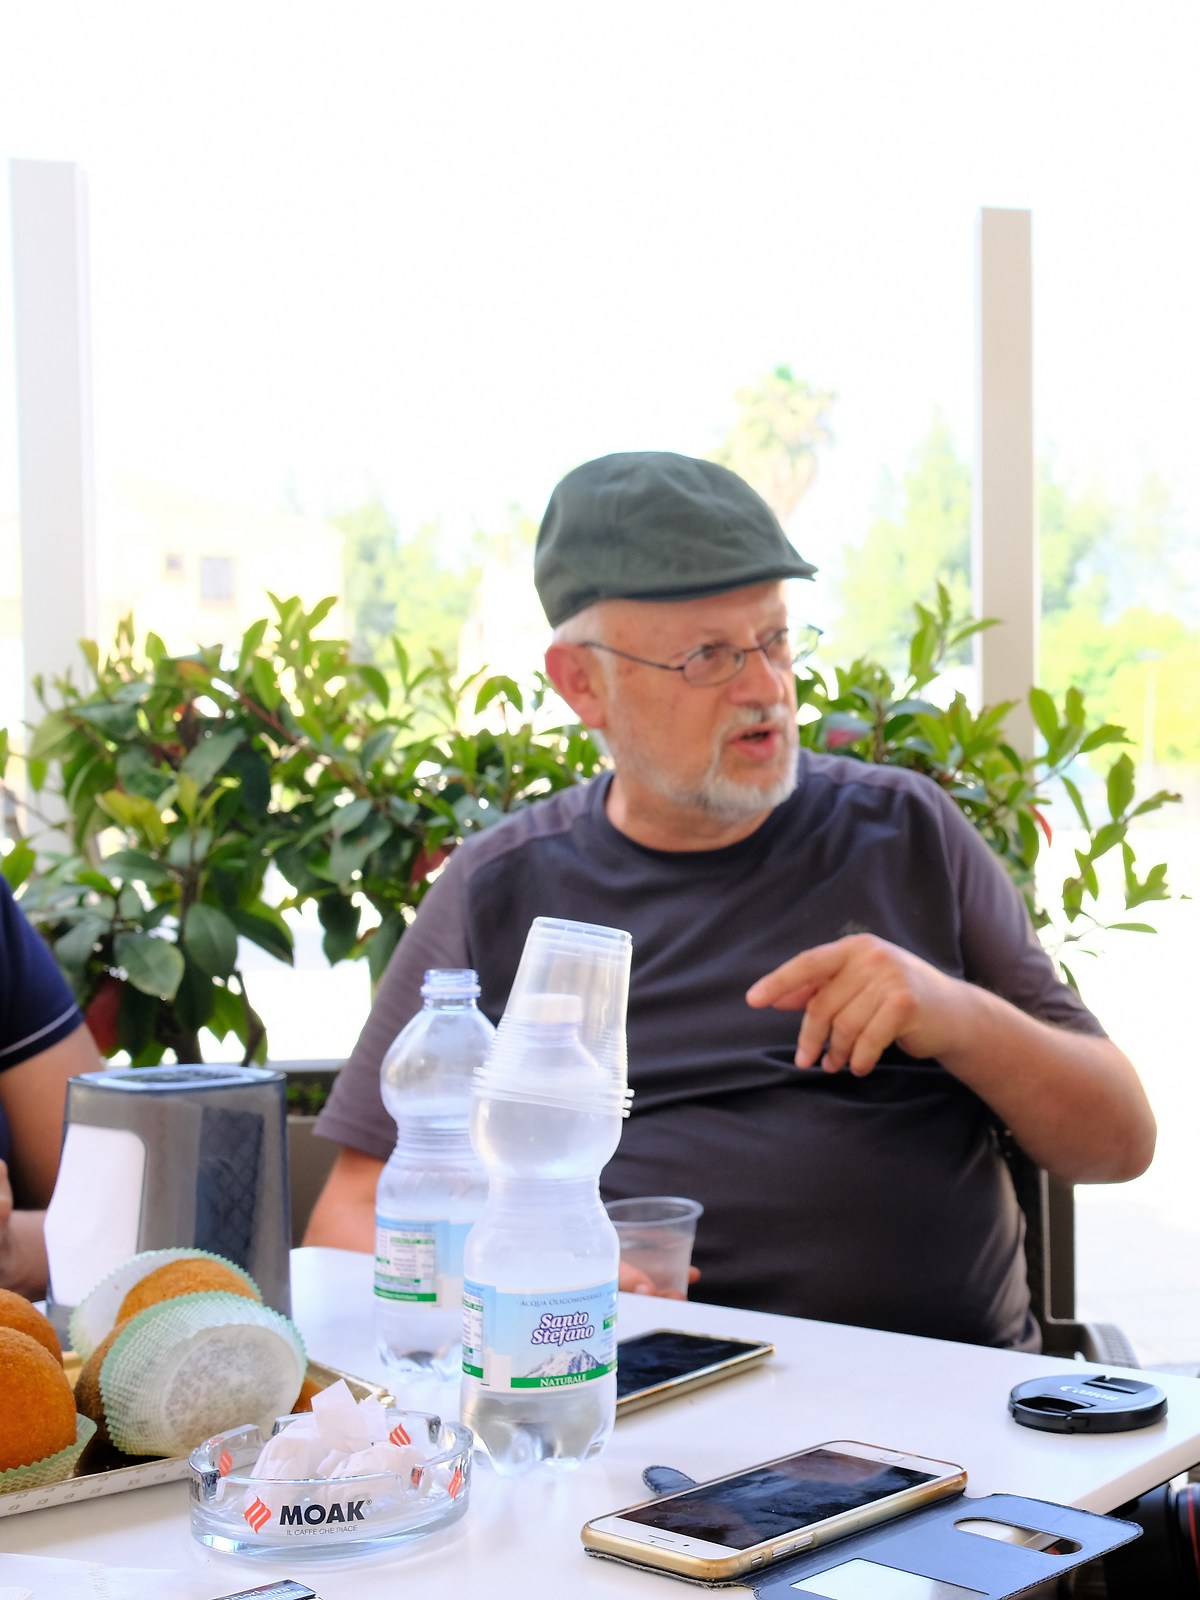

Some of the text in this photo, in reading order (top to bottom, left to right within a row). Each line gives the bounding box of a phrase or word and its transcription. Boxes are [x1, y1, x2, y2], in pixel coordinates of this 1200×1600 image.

[540, 1311, 589, 1330] Santo
[531, 1325, 595, 1346] Stefano
[540, 1374, 588, 1387] NATURALE
[319, 1527, 335, 1535] CHE
[336, 1525, 358, 1534] PIACE
